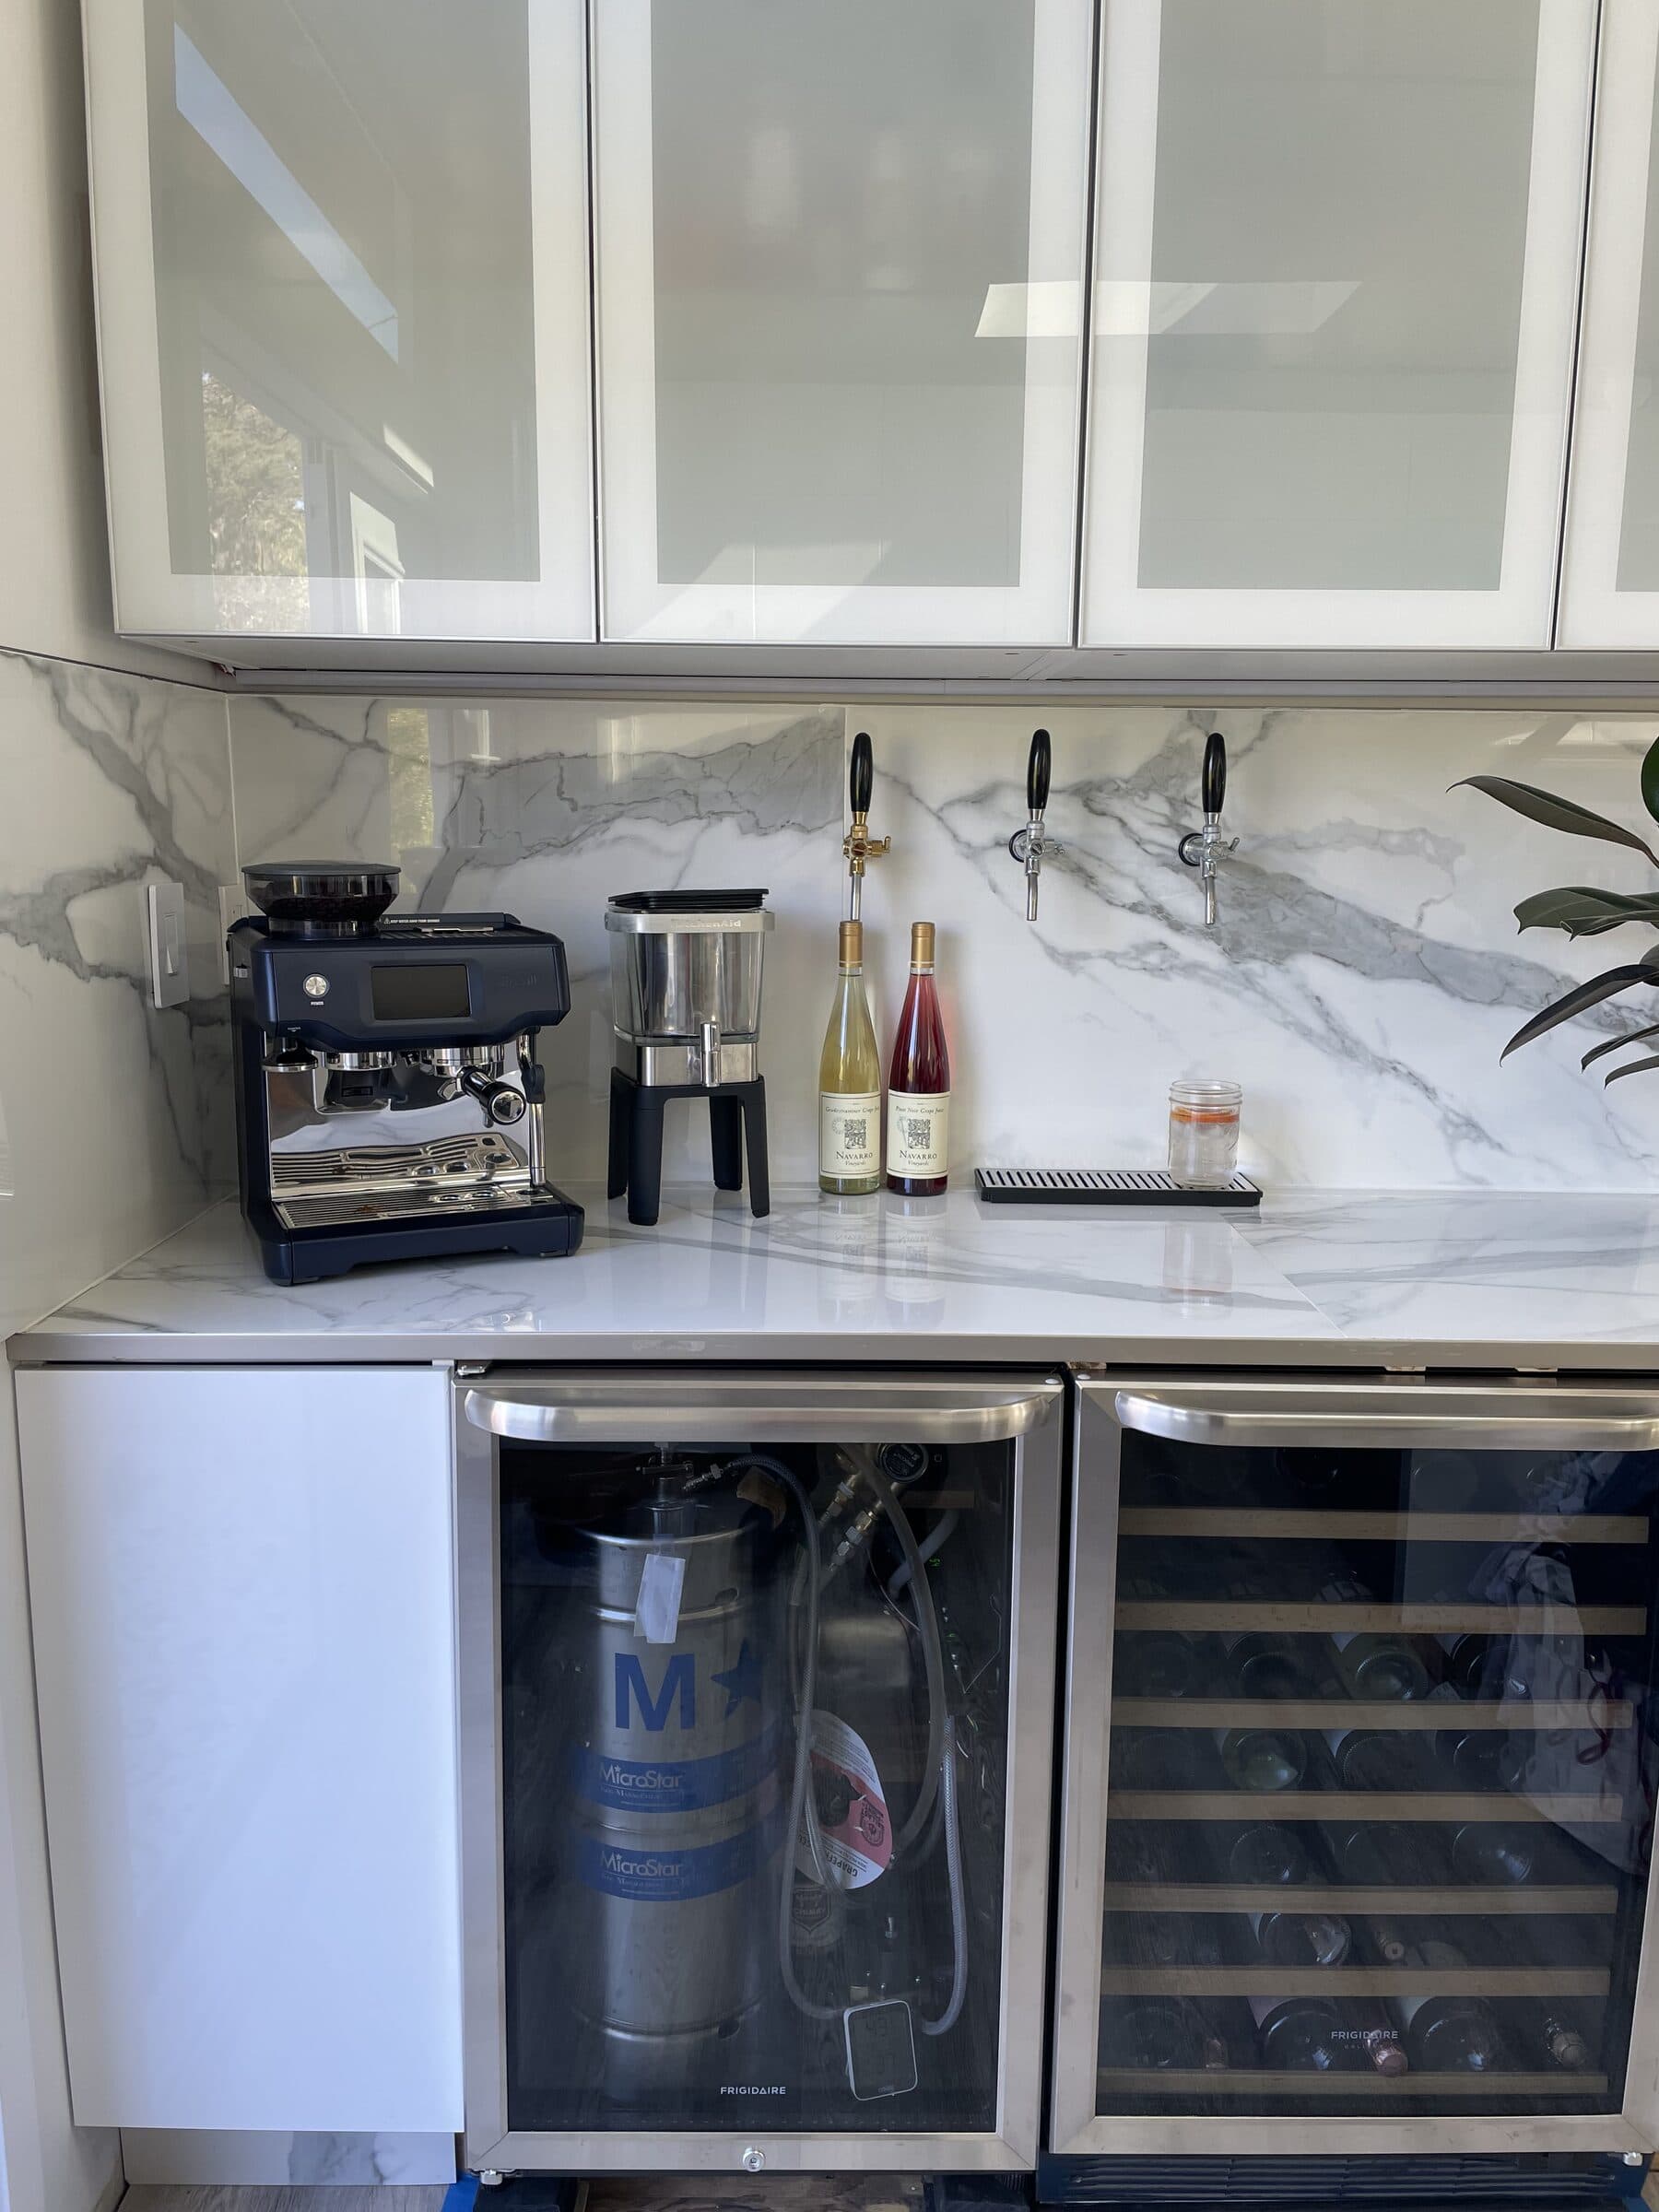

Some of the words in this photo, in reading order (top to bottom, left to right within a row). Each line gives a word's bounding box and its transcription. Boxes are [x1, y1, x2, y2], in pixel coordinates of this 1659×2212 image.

[614, 1653, 696, 1732] M
[599, 1763, 683, 1789] MicroStar
[600, 1851, 683, 1877] MicroStar
[720, 2086, 786, 2095] FRIGIDAIRE
